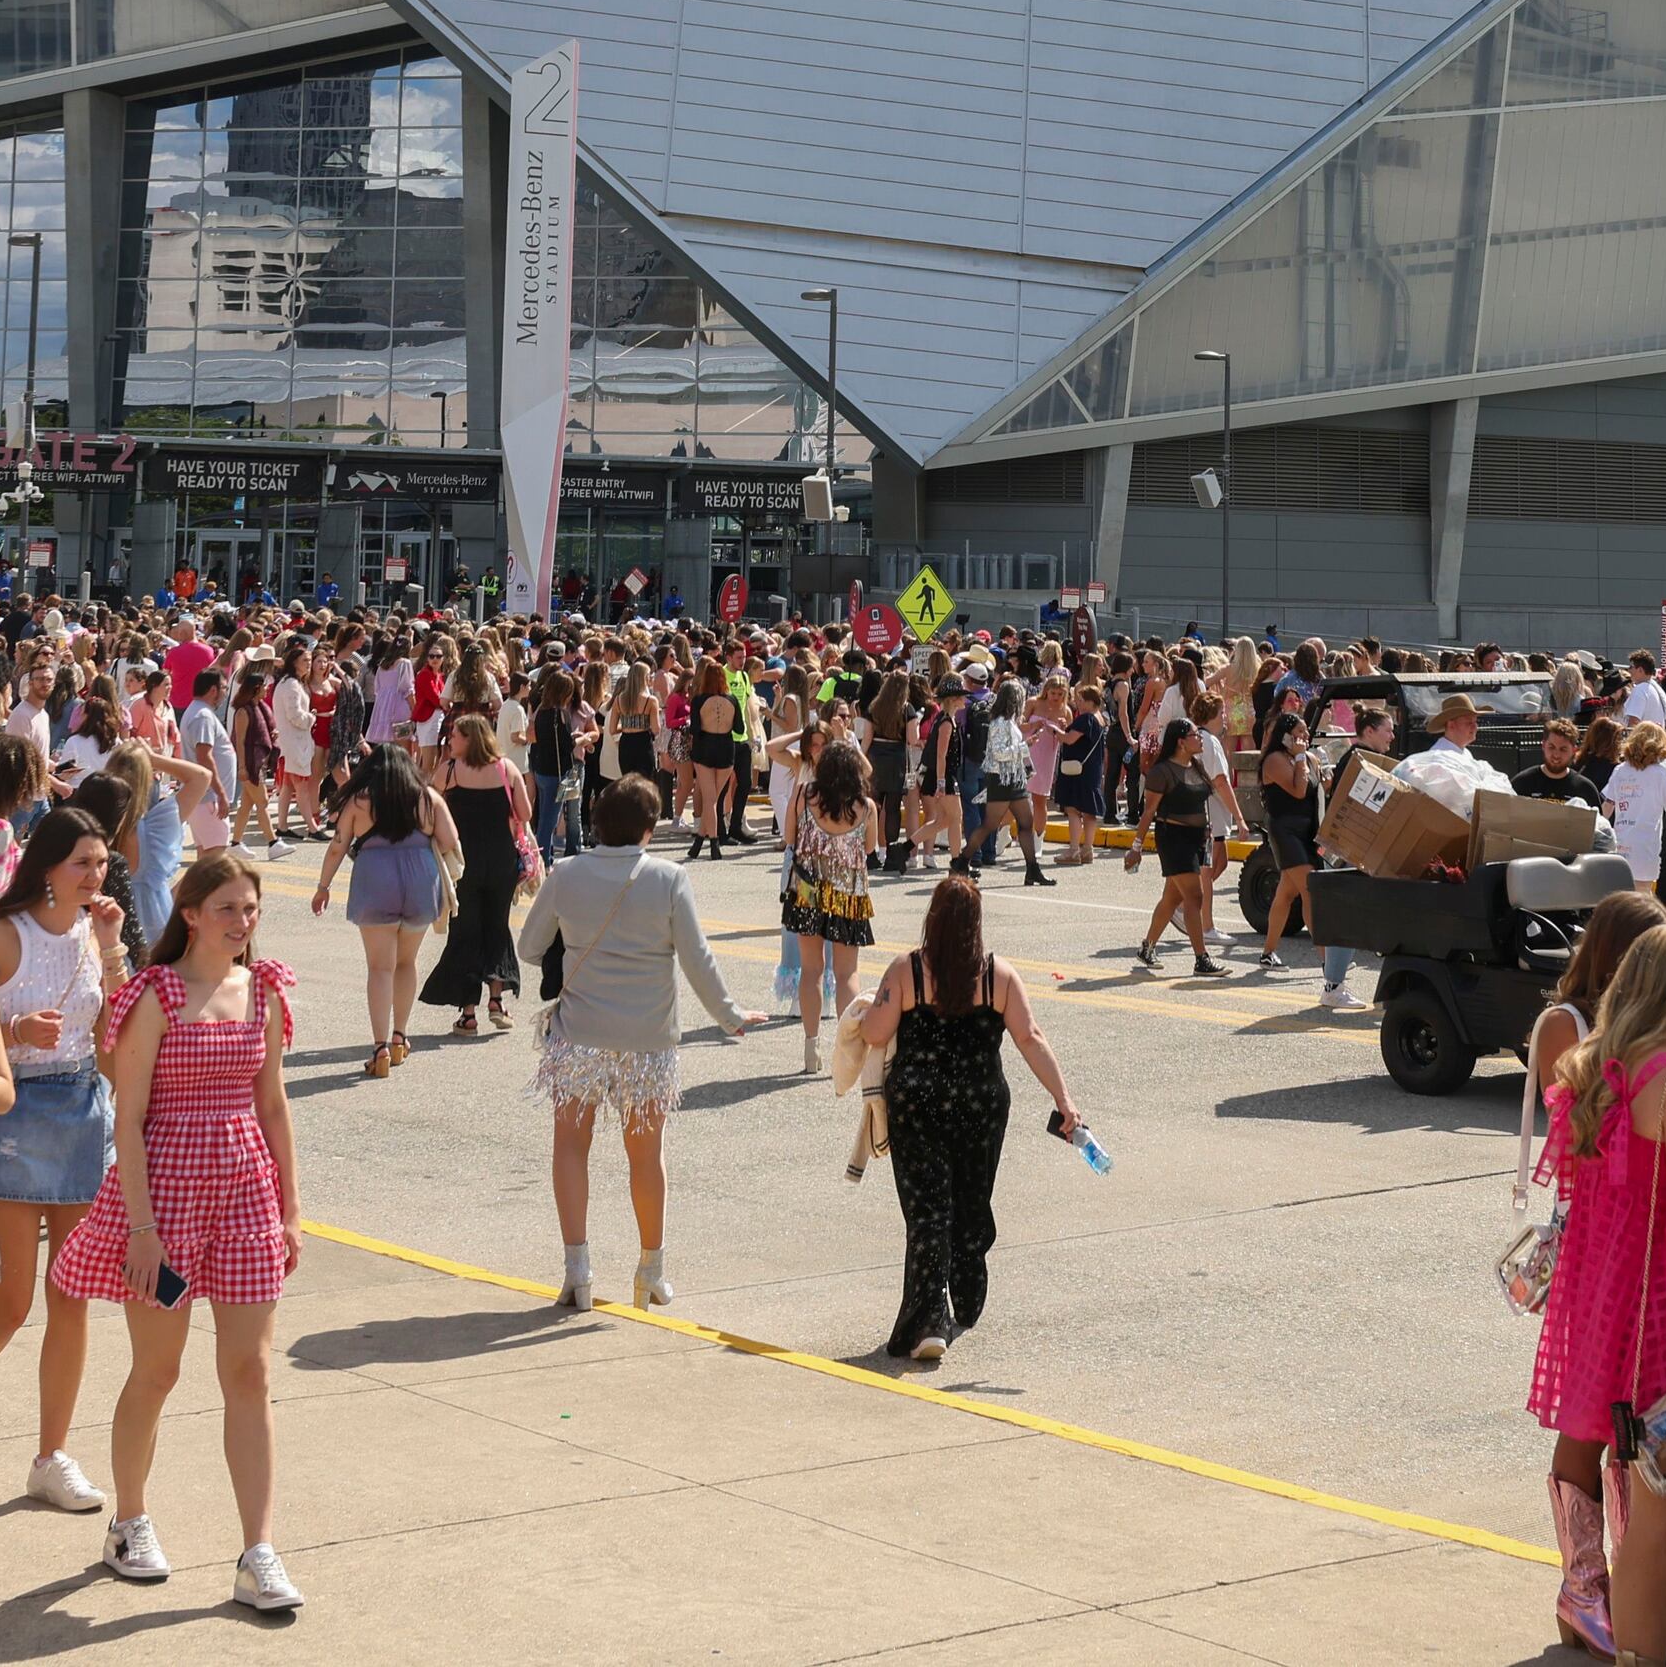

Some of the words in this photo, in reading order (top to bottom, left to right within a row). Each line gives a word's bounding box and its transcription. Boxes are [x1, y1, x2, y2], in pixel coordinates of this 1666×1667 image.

[516, 150, 544, 346] Mercedes-Benz
[546, 195, 561, 305] STADIUM
[111, 433, 138, 472] 2
[167, 459, 205, 474] HAVE
[208, 461, 246, 475] YOUR
[250, 462, 301, 477] TICKET
[30, 472, 53, 482] FREE
[56, 472, 82, 483] WIFI:
[83, 473, 125, 484] ATTWIFI
[177, 474, 225, 489] READY
[228, 476, 246, 490] TO
[249, 477, 288, 491] SCAN
[406, 472, 488, 486] Mercedes-Benz
[561, 477, 594, 488] FASTER
[595, 478, 626, 489] ENTRY
[423, 486, 469, 495] STADIUM
[567, 489, 591, 498] FREE
[593, 489, 616, 499] WIFI:
[617, 490, 654, 500] ATTWIFI
[695, 480, 729, 494] HAVE
[731, 481, 764, 495] YOUR
[767, 482, 802, 496] TICKE
[704, 495, 746, 508] READY
[749, 495, 764, 508] TO
[766, 496, 800, 509] SCAN
[914, 650, 930, 658] SPEE
